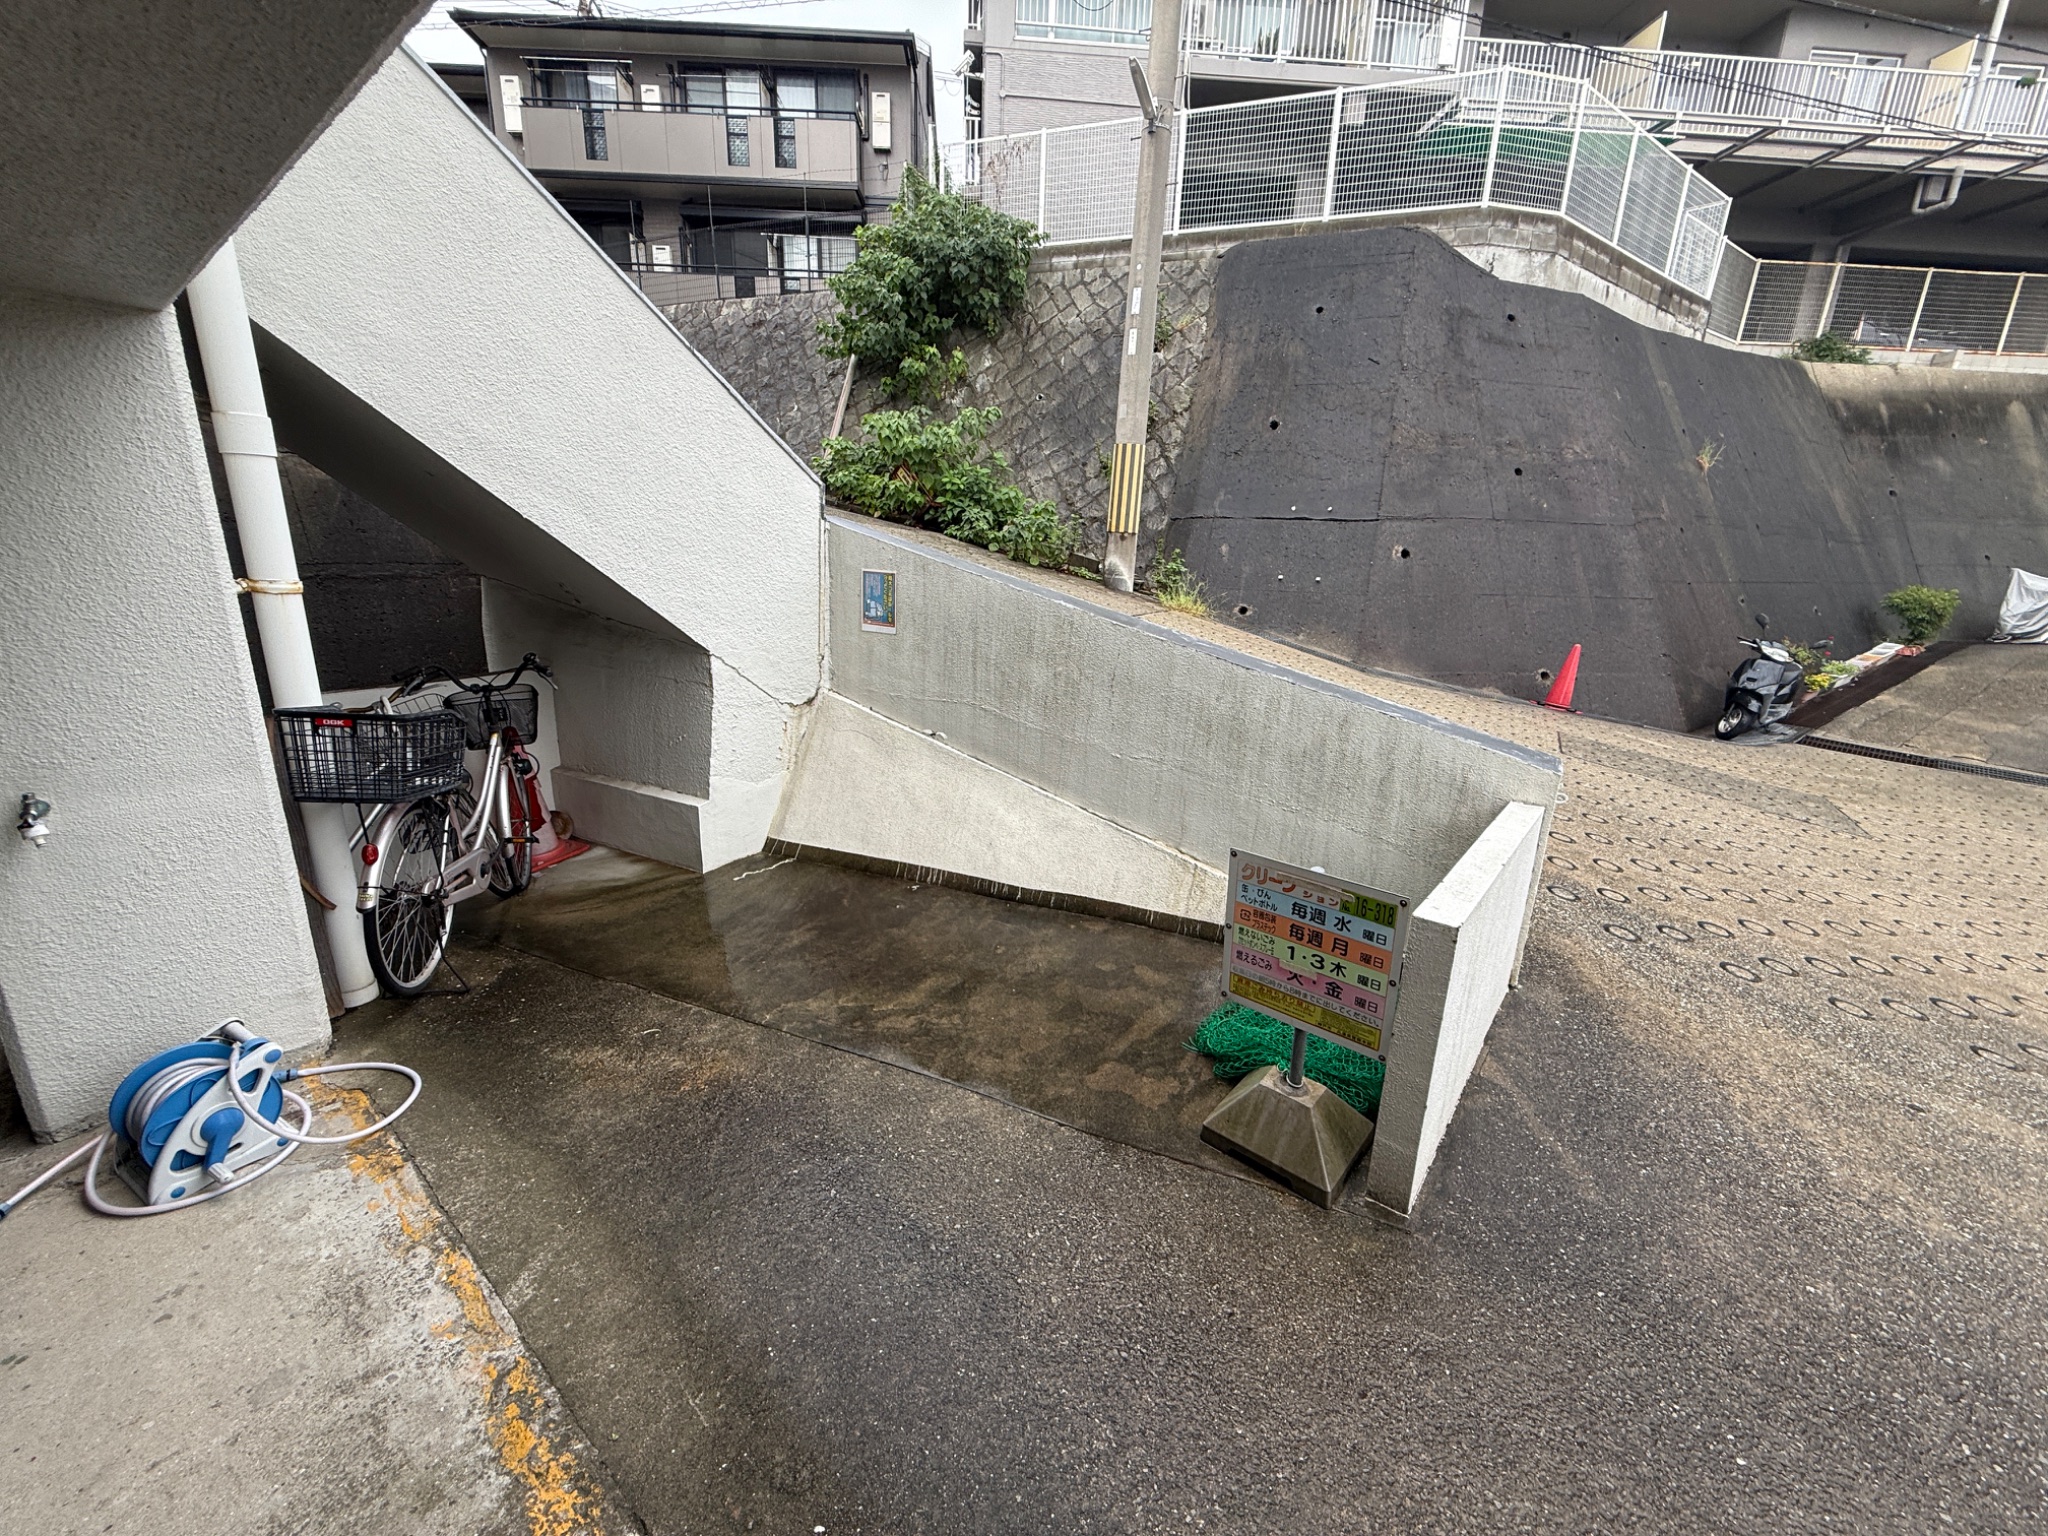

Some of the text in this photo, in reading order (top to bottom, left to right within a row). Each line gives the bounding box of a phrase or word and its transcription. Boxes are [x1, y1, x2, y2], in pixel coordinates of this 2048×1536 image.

[1355, 896, 1395, 925] 16-318
[1291, 901, 1387, 946] 毎週 水 曜日
[1289, 922, 1384, 969] 毎週 月 曜日
[1236, 950, 1272, 971] 燃えるごみ
[1357, 974, 1381, 991] 曜日
[1354, 996, 1378, 1013] 曜日
